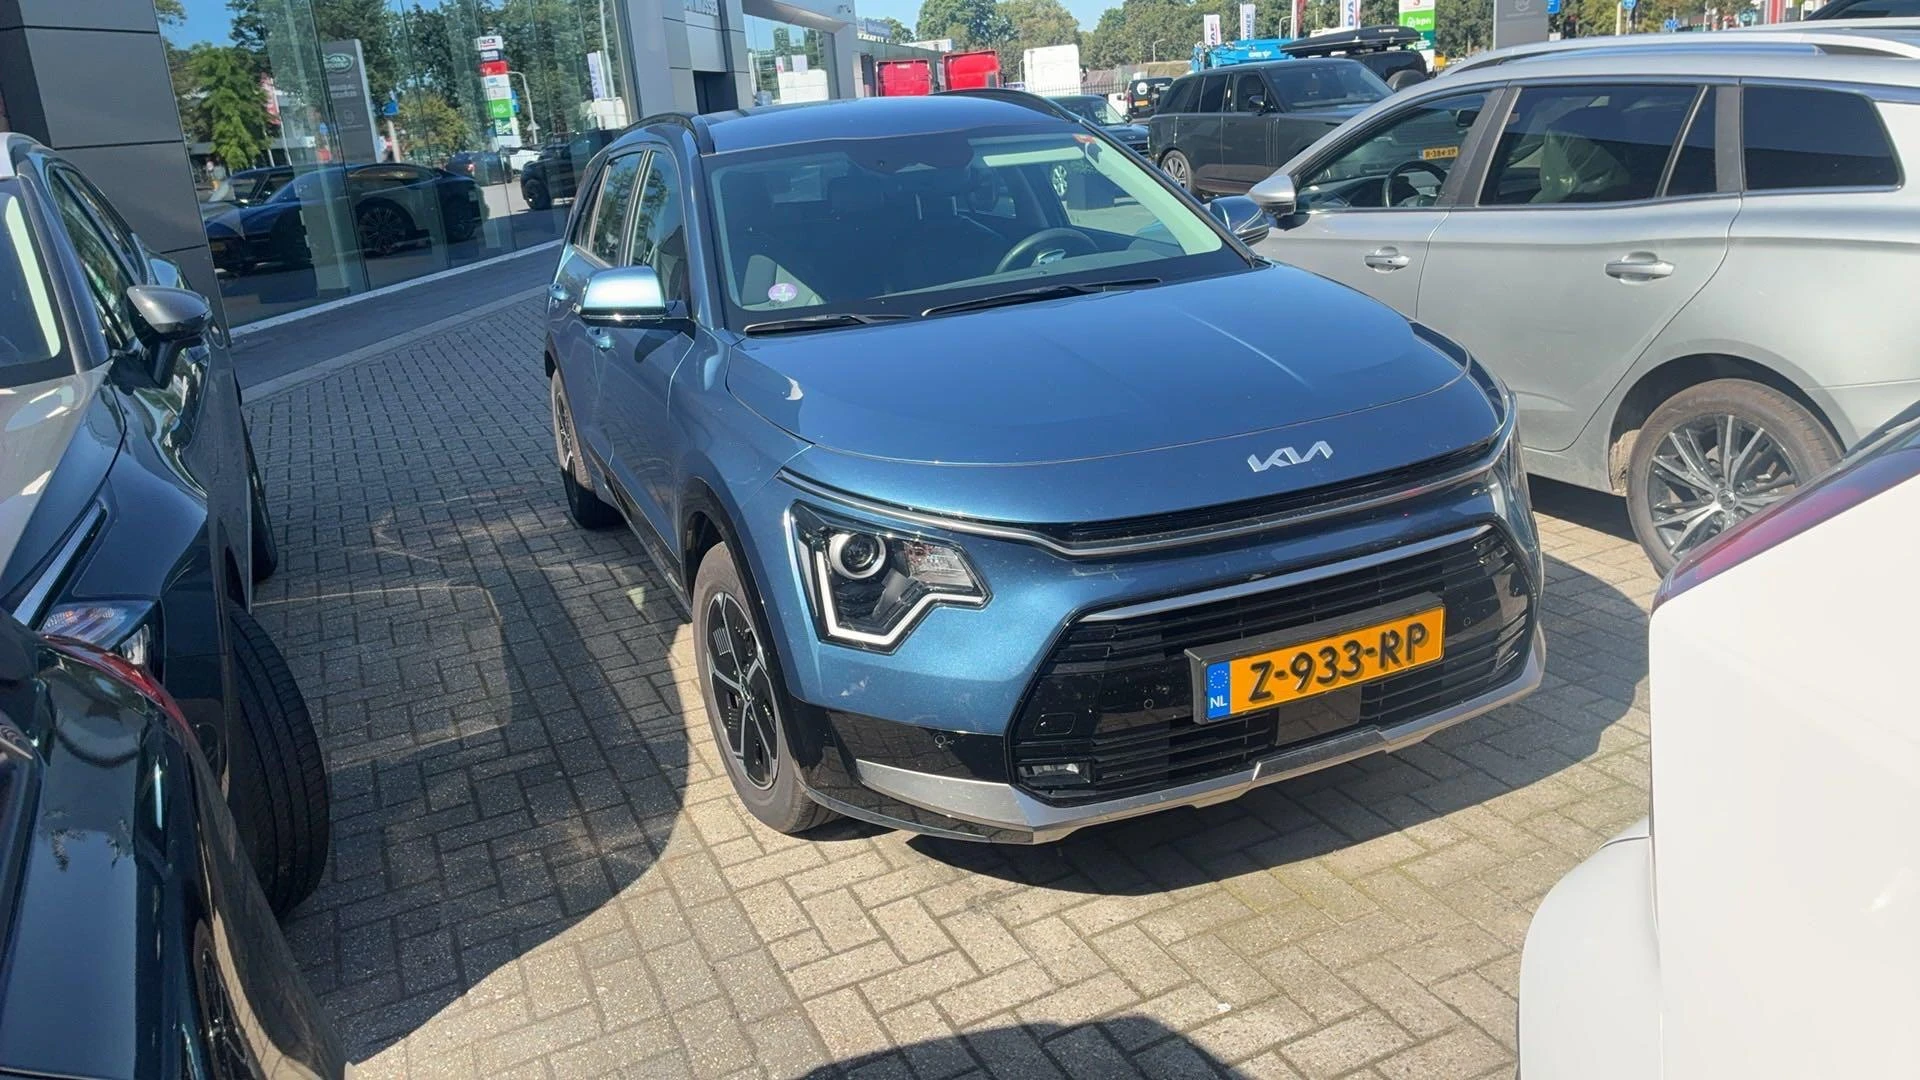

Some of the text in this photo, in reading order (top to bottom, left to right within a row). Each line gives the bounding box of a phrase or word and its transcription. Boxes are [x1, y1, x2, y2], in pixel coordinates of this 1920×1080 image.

[1247, 440, 1334, 472] KIA
[1249, 622, 1427, 703] Z-933-RP
[1210, 695, 1227, 709] NL
